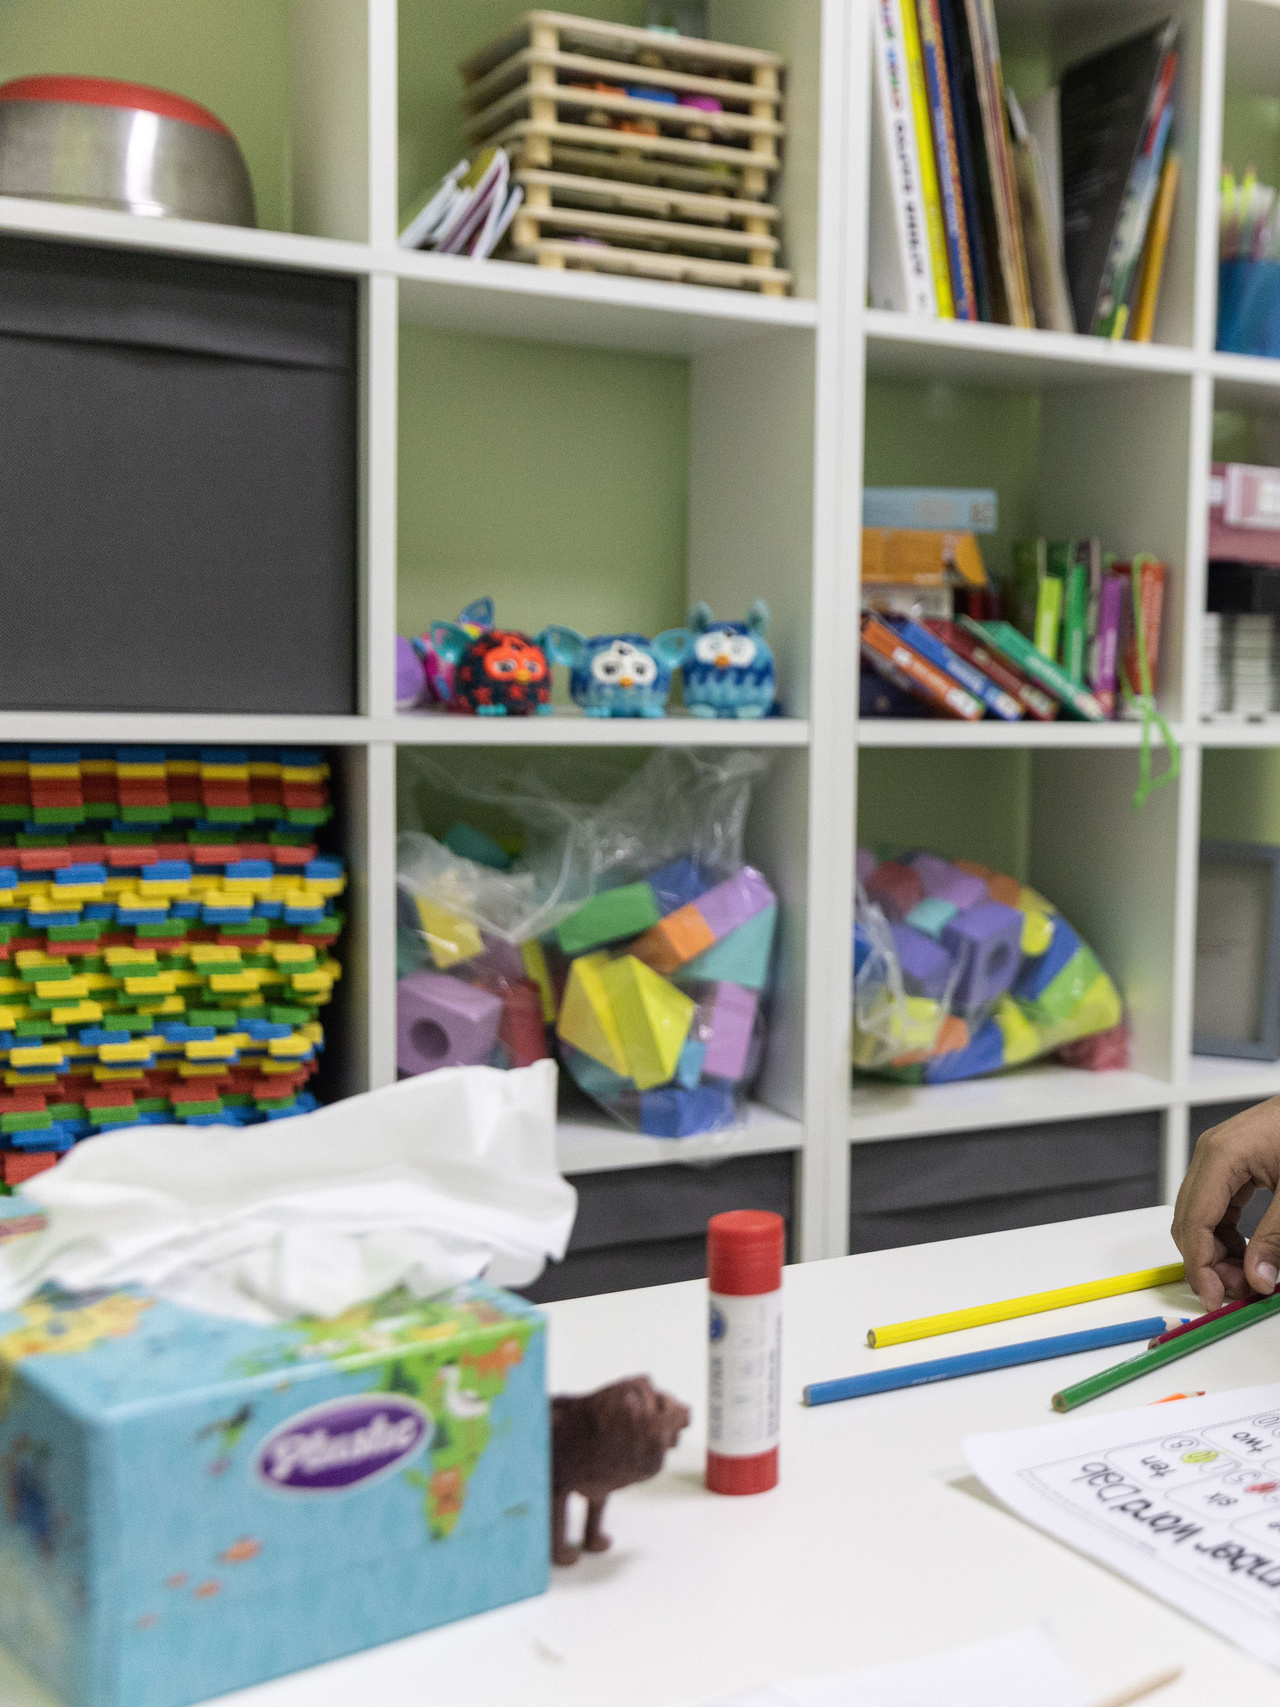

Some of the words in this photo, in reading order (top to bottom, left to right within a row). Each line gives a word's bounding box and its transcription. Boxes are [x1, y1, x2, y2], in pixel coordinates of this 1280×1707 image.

[1232, 1431, 1273, 1454] two
[1140, 1455, 1177, 1478] ten
[1071, 1462, 1143, 1501] Dab
[1205, 1491, 1239, 1507] six
[1108, 1499, 1204, 1544] Word
